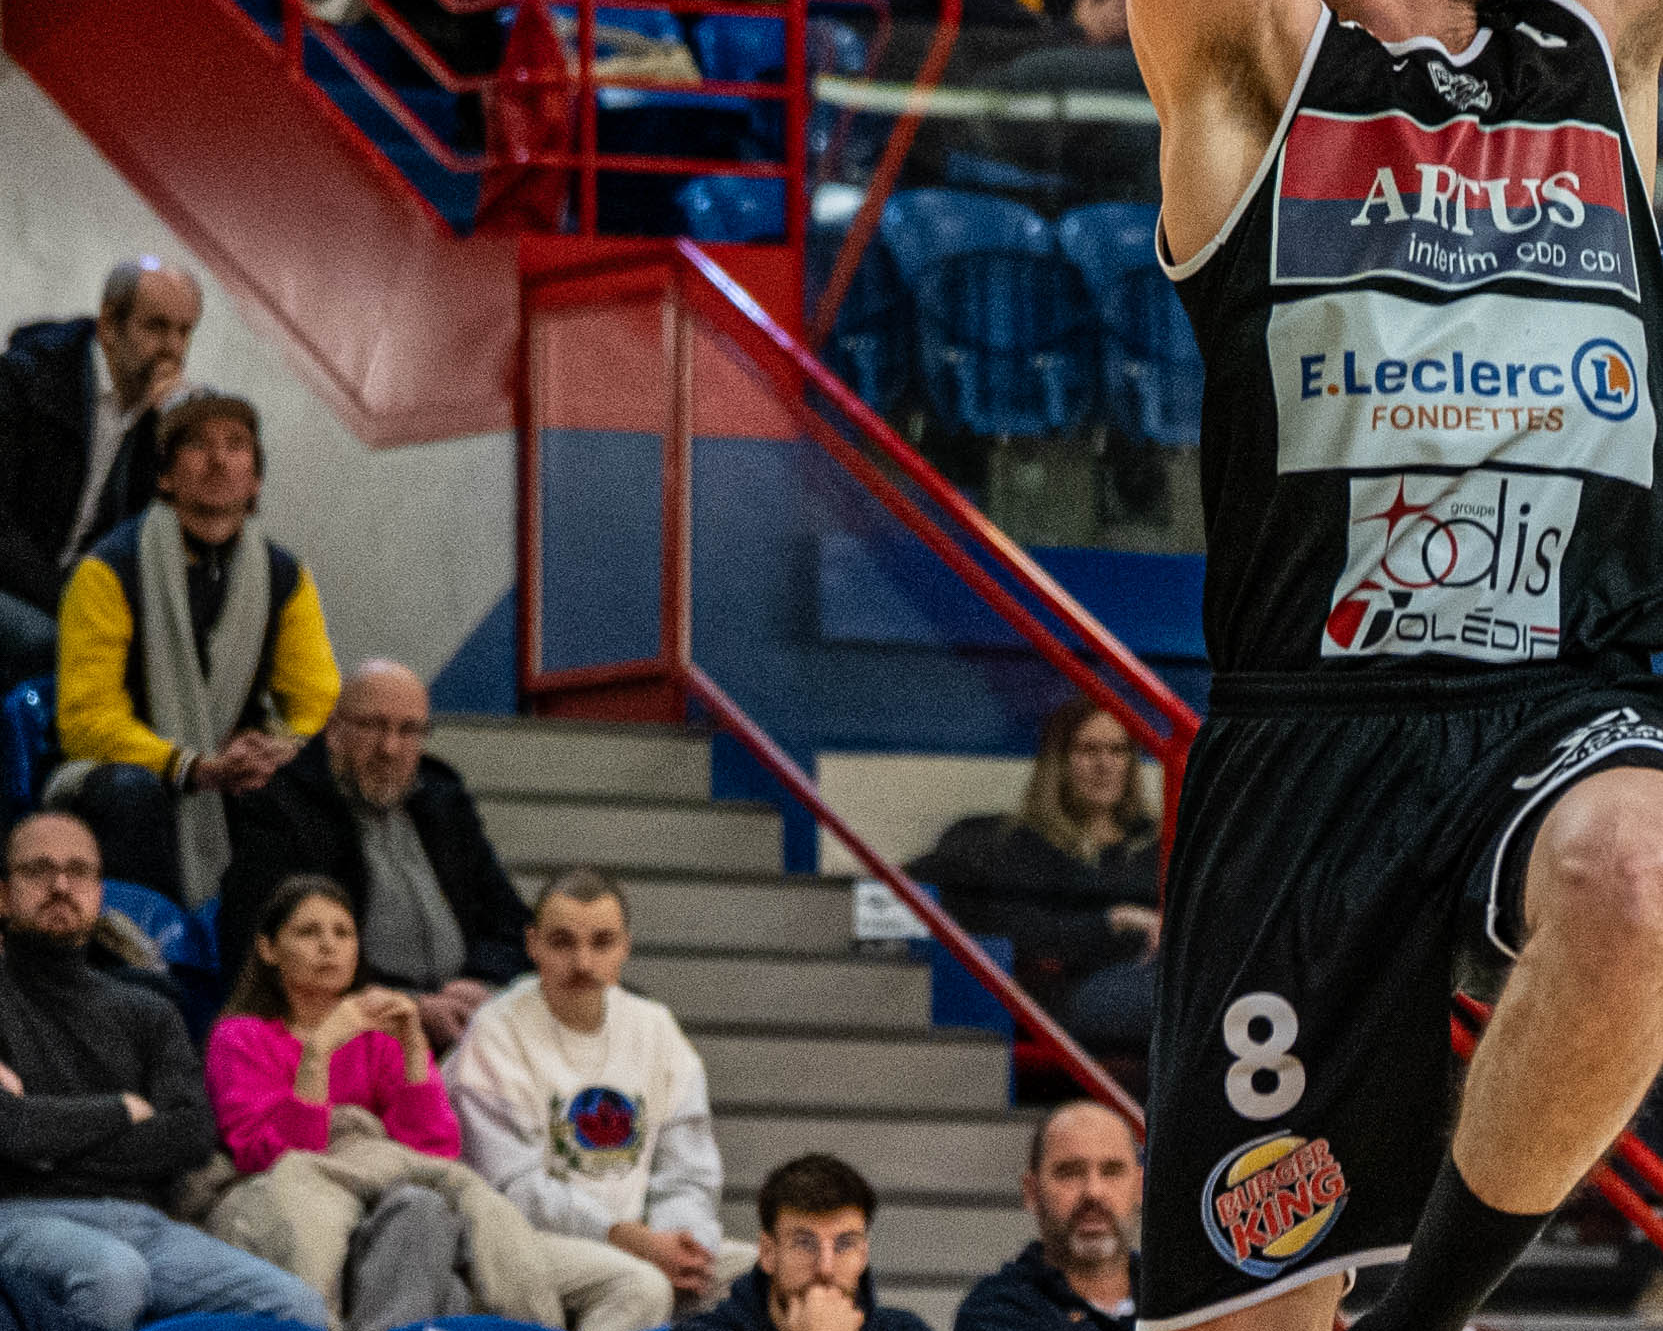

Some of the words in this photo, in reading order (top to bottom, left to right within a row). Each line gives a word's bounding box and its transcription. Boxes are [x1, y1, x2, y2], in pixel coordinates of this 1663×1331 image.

[1350, 163, 1587, 237] ARTUS
[1408, 232, 1499, 274] interim
[1517, 242, 1567, 268] CDD
[1580, 249, 1622, 274] CDI
[1300, 350, 1566, 400] E.Leclerc
[1370, 404, 1565, 434] FONDETTES
[1450, 501, 1496, 518] groupe
[1223, 991, 1306, 1121] 8
[1216, 1138, 1335, 1228] BURGER
[1230, 1161, 1346, 1263] KING
